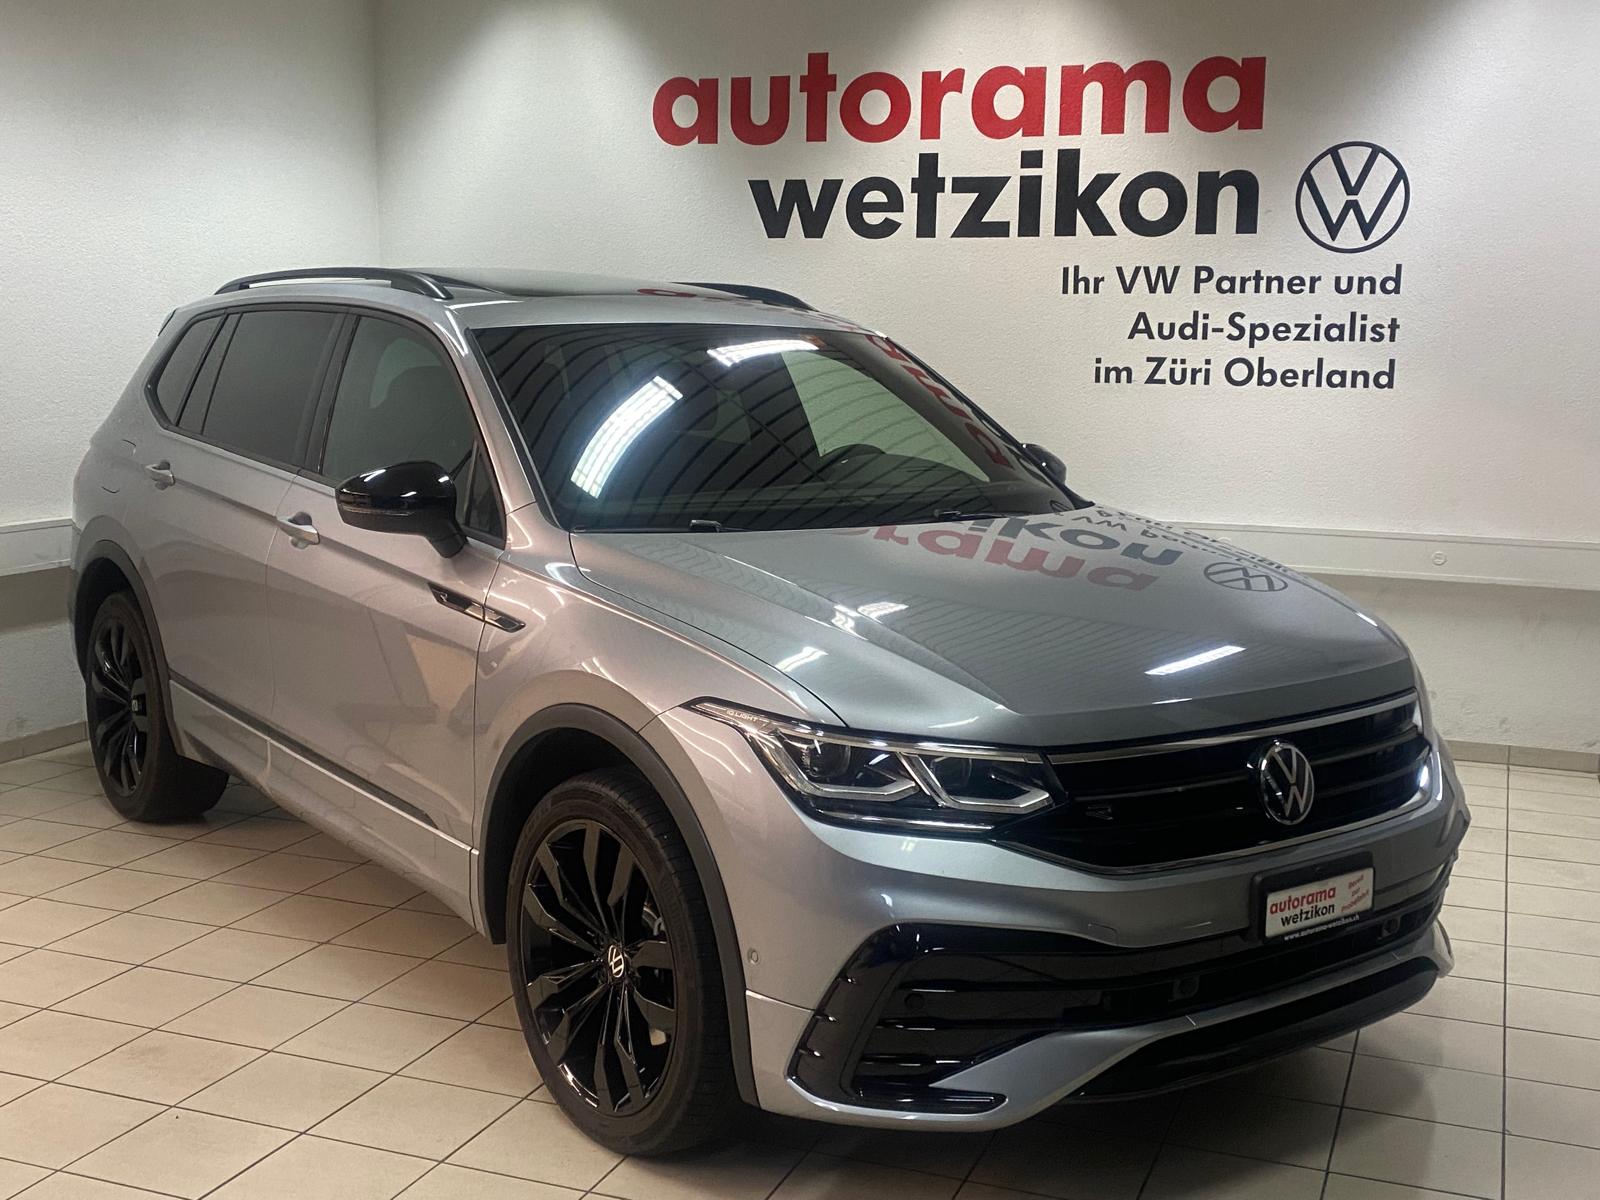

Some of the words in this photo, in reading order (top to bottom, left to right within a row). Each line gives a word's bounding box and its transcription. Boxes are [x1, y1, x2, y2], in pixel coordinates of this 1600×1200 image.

[653, 53, 1266, 146] autorama
[747, 149, 1259, 239] wetzikon
[1062, 266, 1105, 294] Ihr
[1115, 265, 1180, 294] VW
[1193, 265, 1322, 295] Partner
[1334, 263, 1402, 295] und
[1127, 310, 1400, 343] Audi-Spezialist
[1094, 357, 1133, 384] im
[1144, 356, 1211, 386] Züri
[1224, 356, 1396, 389] Oberland
[1269, 886, 1337, 915] autorama
[1280, 903, 1335, 927] wetzikon
